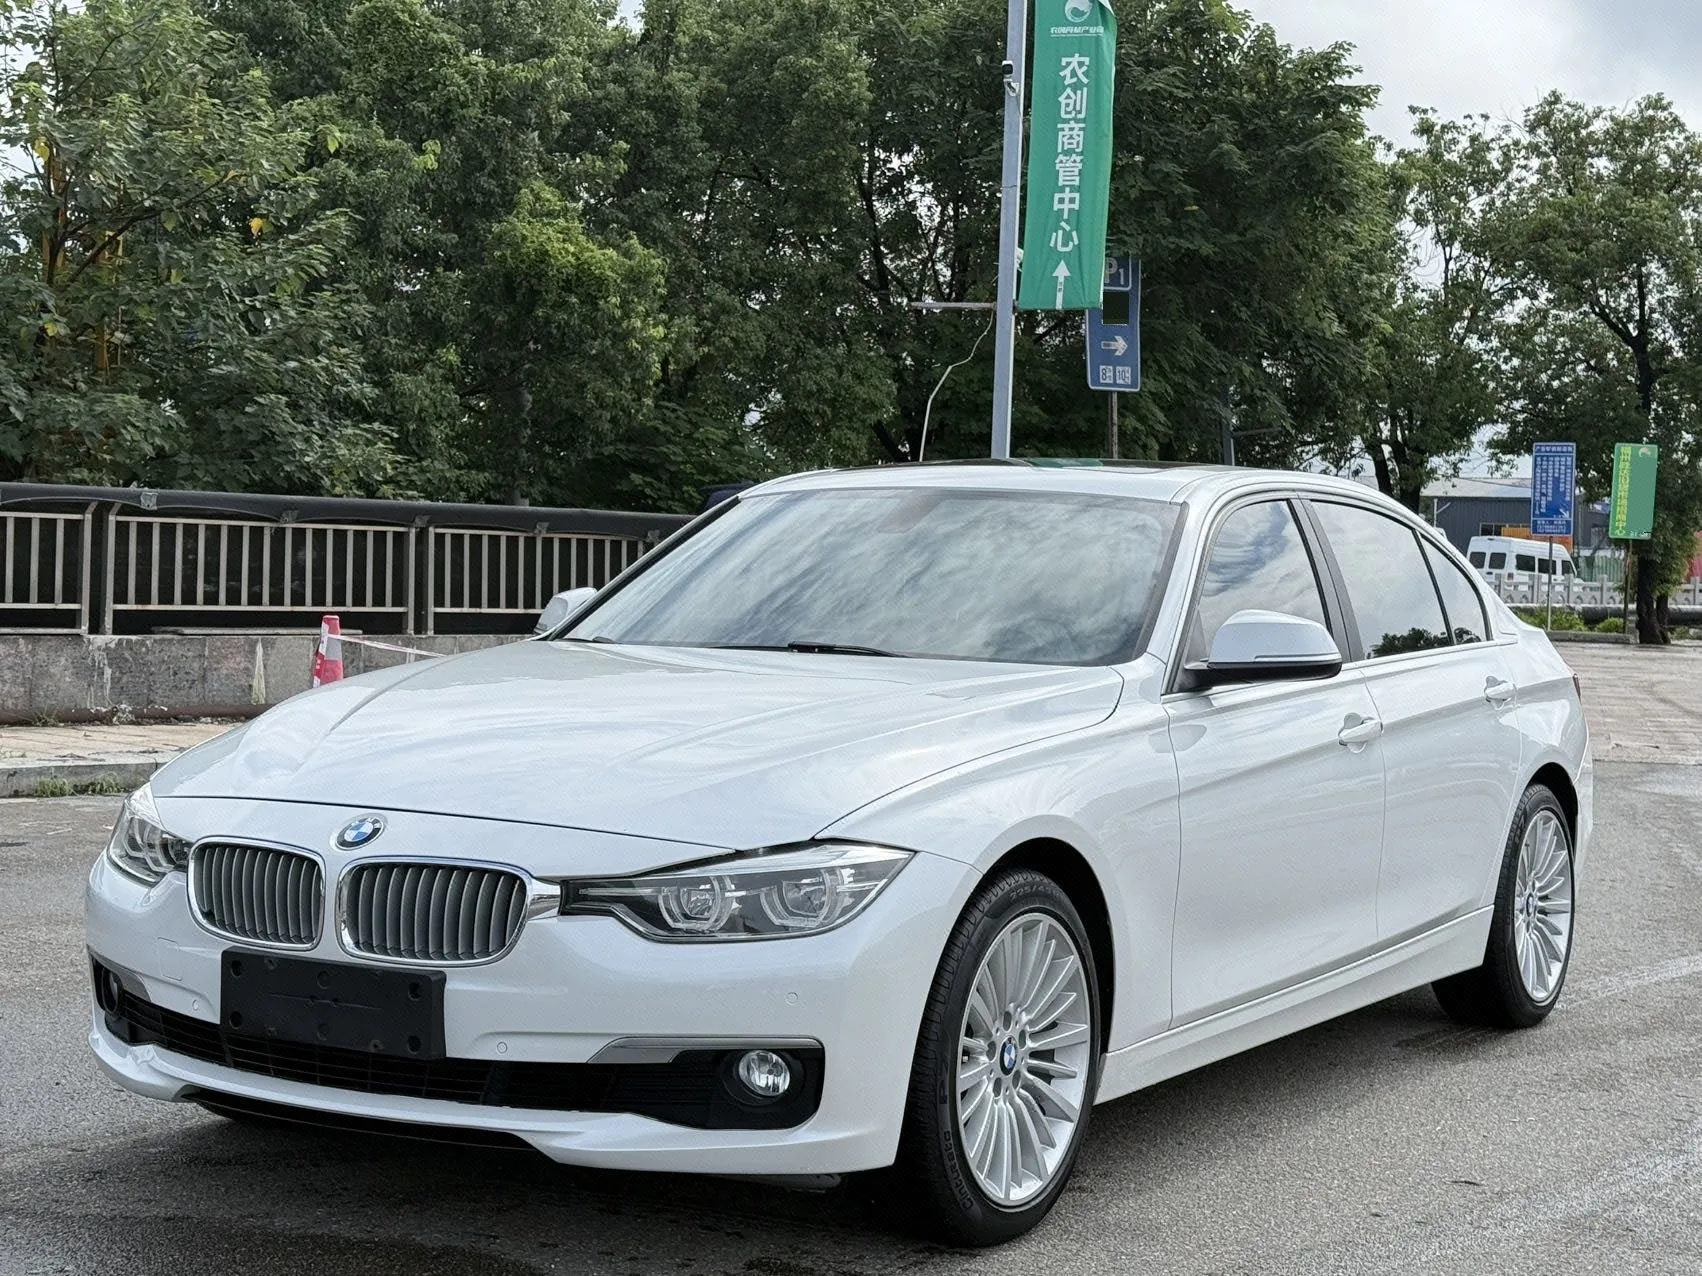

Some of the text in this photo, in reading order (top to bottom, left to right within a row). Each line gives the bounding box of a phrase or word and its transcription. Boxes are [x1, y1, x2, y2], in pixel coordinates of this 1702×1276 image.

[1049, 53, 1090, 252] 农创商管中心
